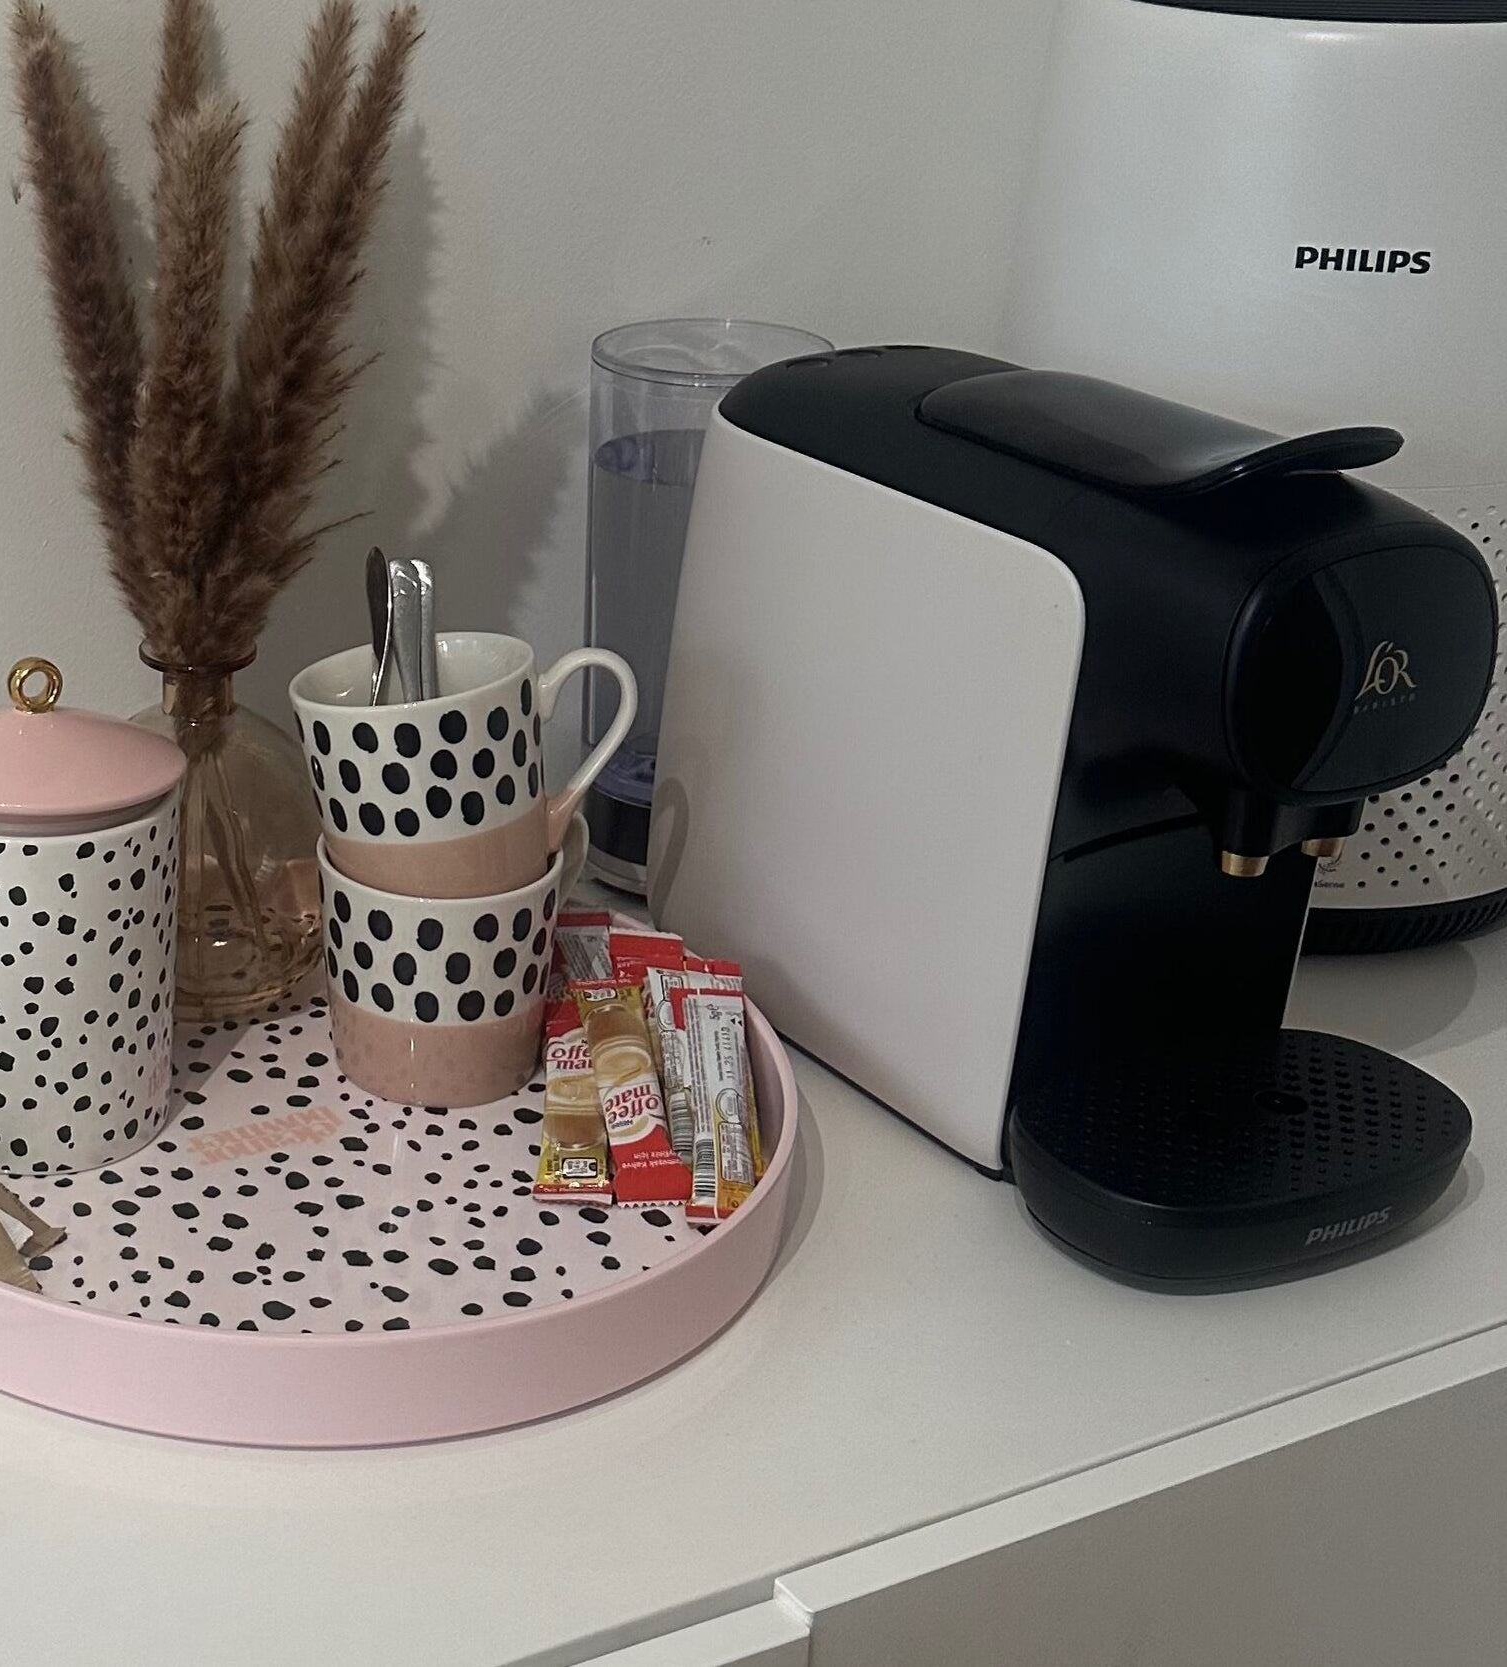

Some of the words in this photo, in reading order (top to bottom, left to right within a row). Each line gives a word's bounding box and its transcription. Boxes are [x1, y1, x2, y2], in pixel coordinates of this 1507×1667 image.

[1295, 246, 1431, 274] PHILIPS
[547, 1041, 591, 1061] Coffe
[604, 1084, 651, 1112] mate
[1304, 1206, 1392, 1247] PHILIPS
